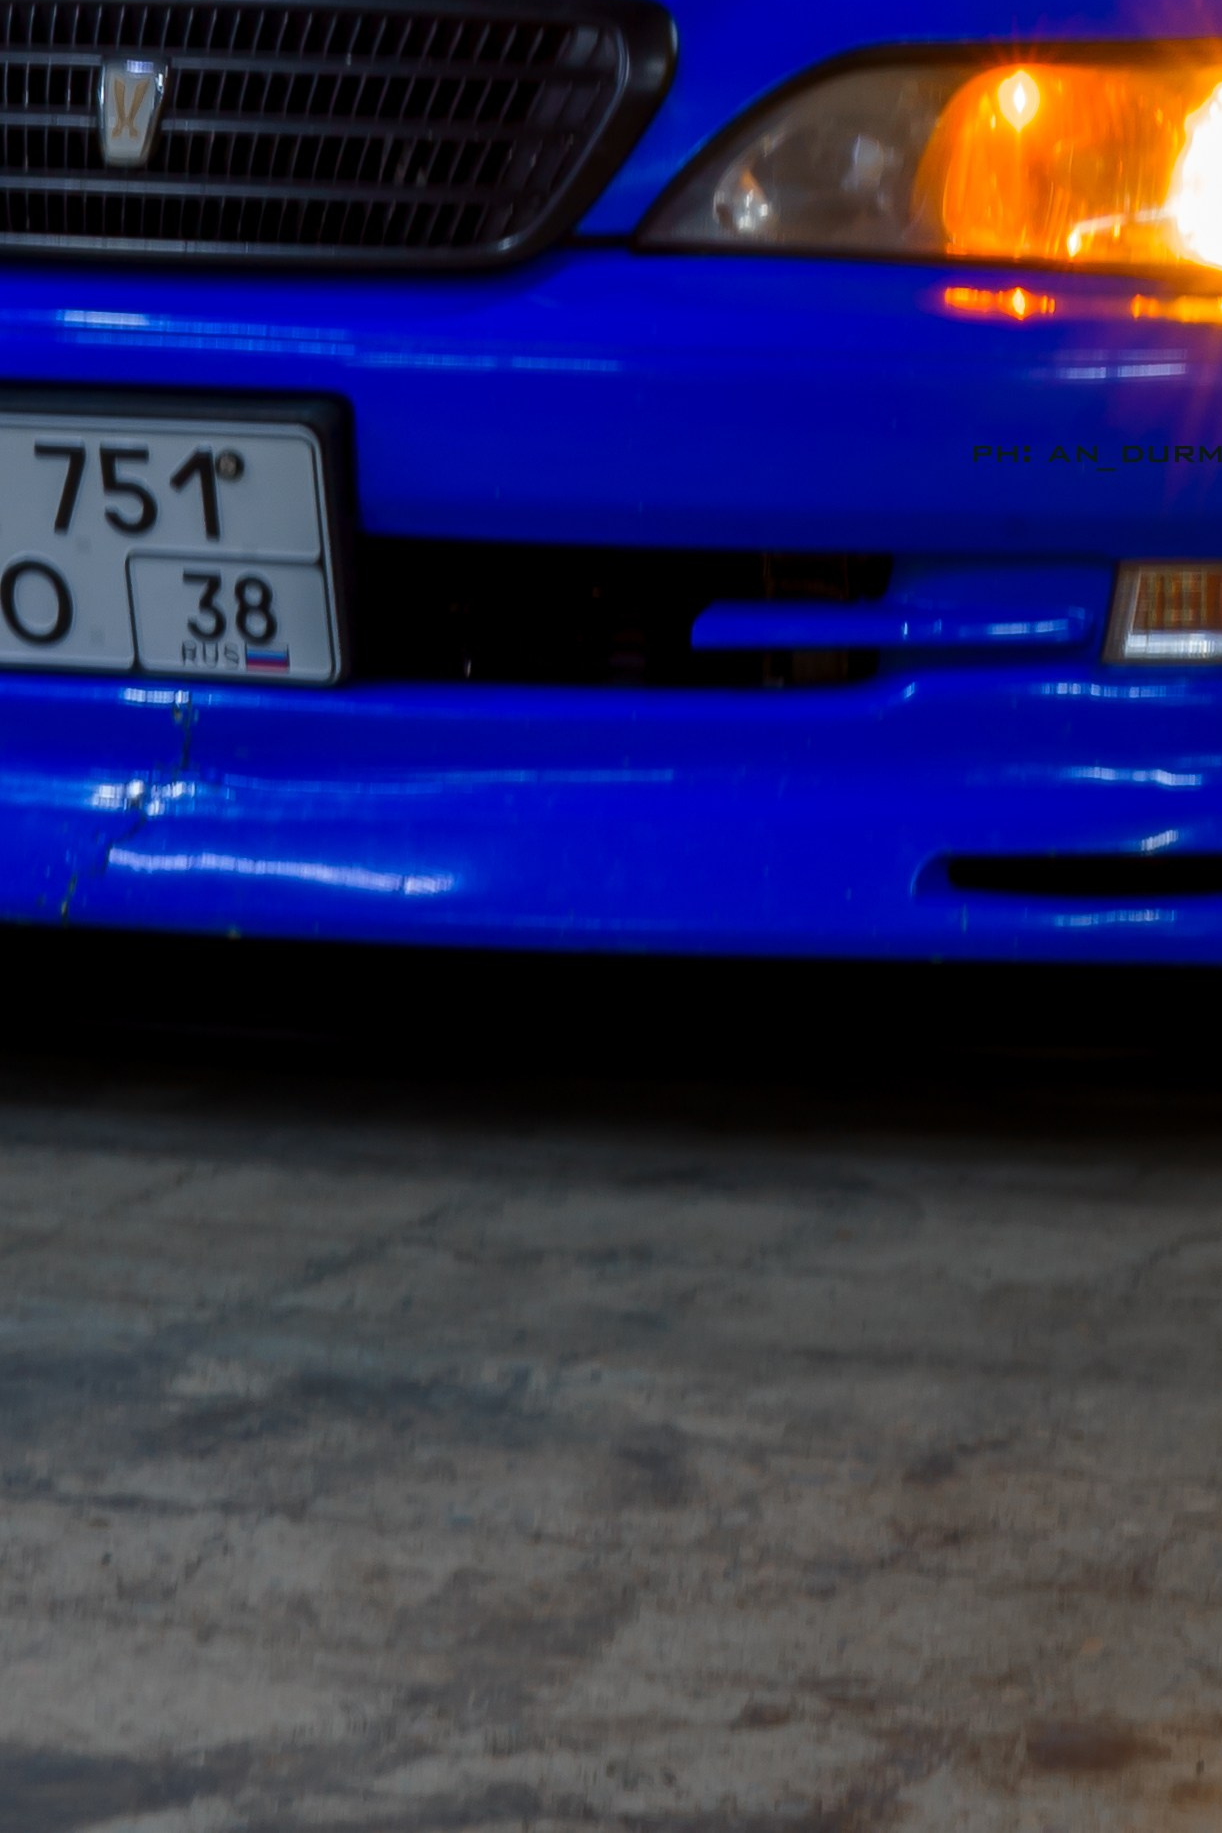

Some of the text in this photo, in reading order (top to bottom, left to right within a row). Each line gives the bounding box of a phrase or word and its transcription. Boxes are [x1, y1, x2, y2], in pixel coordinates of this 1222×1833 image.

[34, 440, 222, 541] 751
[182, 569, 278, 644] 38
[181, 643, 240, 667] RUS
